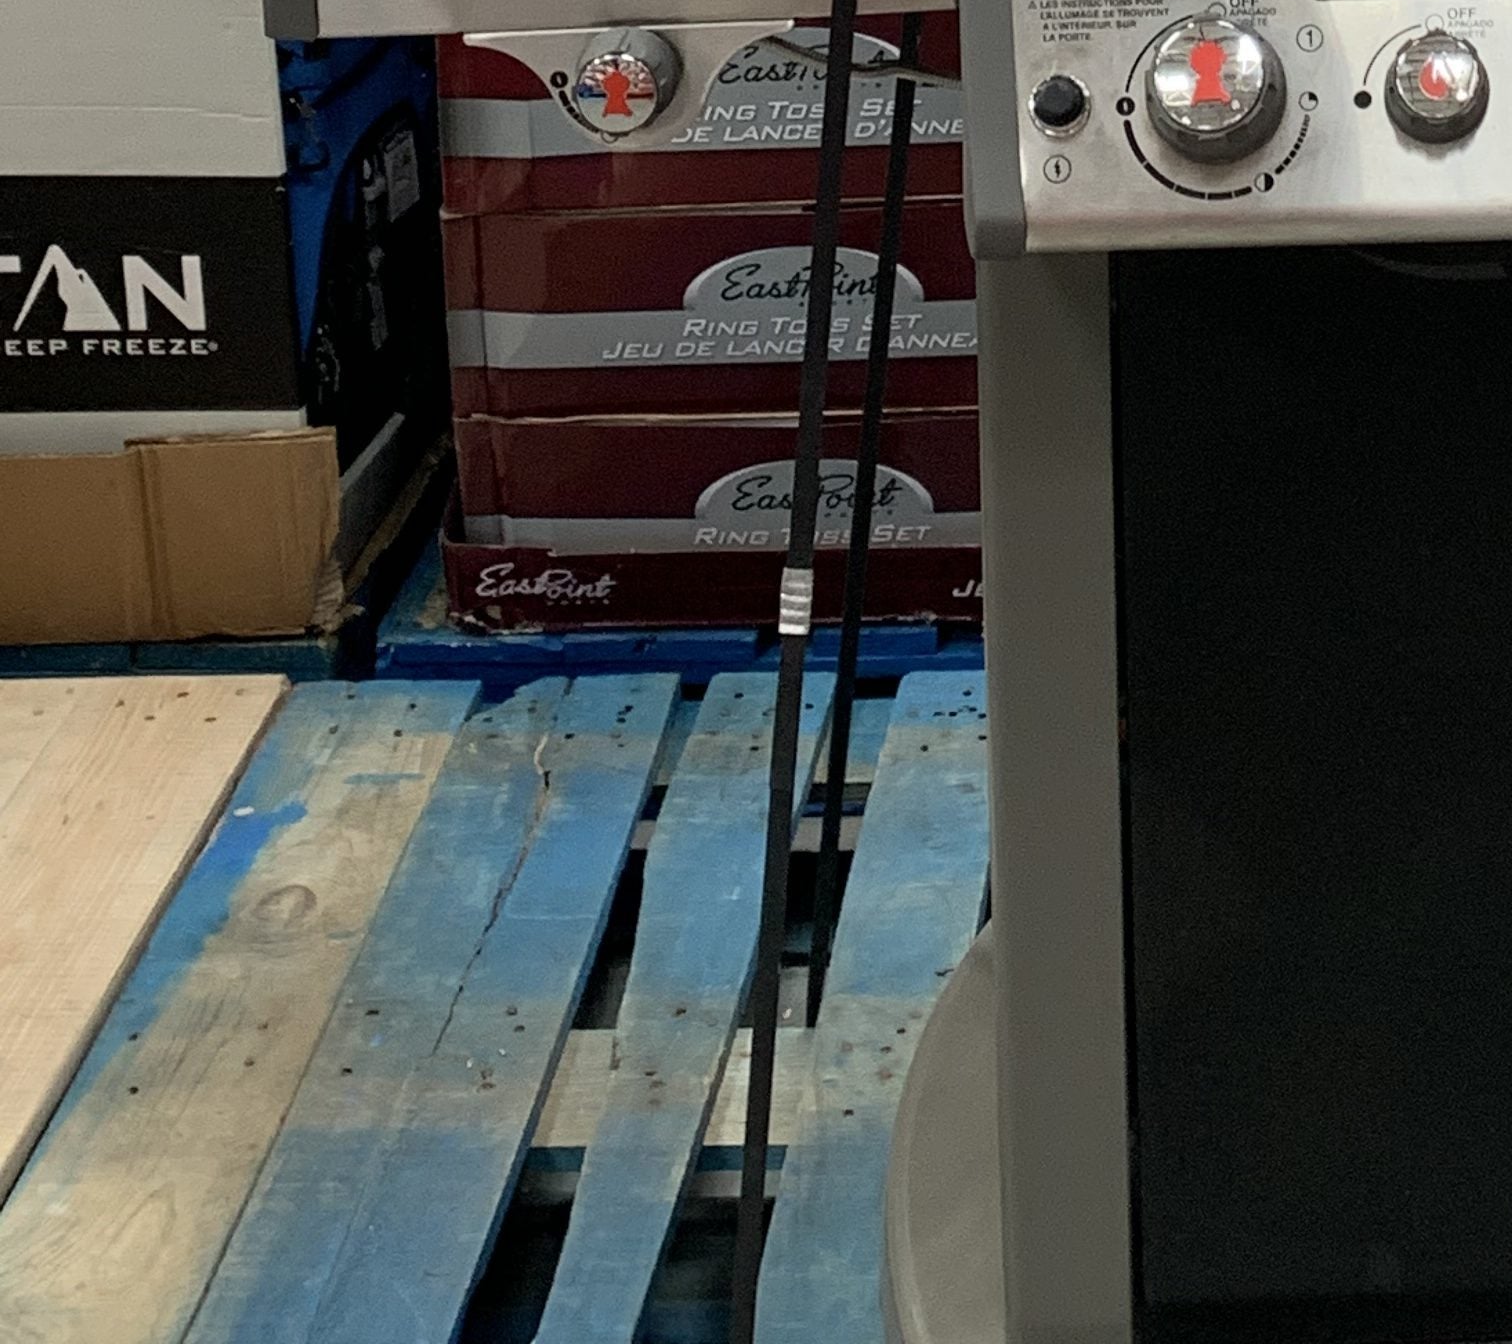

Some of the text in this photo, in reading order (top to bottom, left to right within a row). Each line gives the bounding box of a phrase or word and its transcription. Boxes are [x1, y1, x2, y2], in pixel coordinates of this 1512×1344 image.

[1447, 8, 1476, 19] OFF
[82, 338, 209, 356] FREEZE
[676, 341, 715, 358] DE
[476, 562, 616, 599] EastPoint
